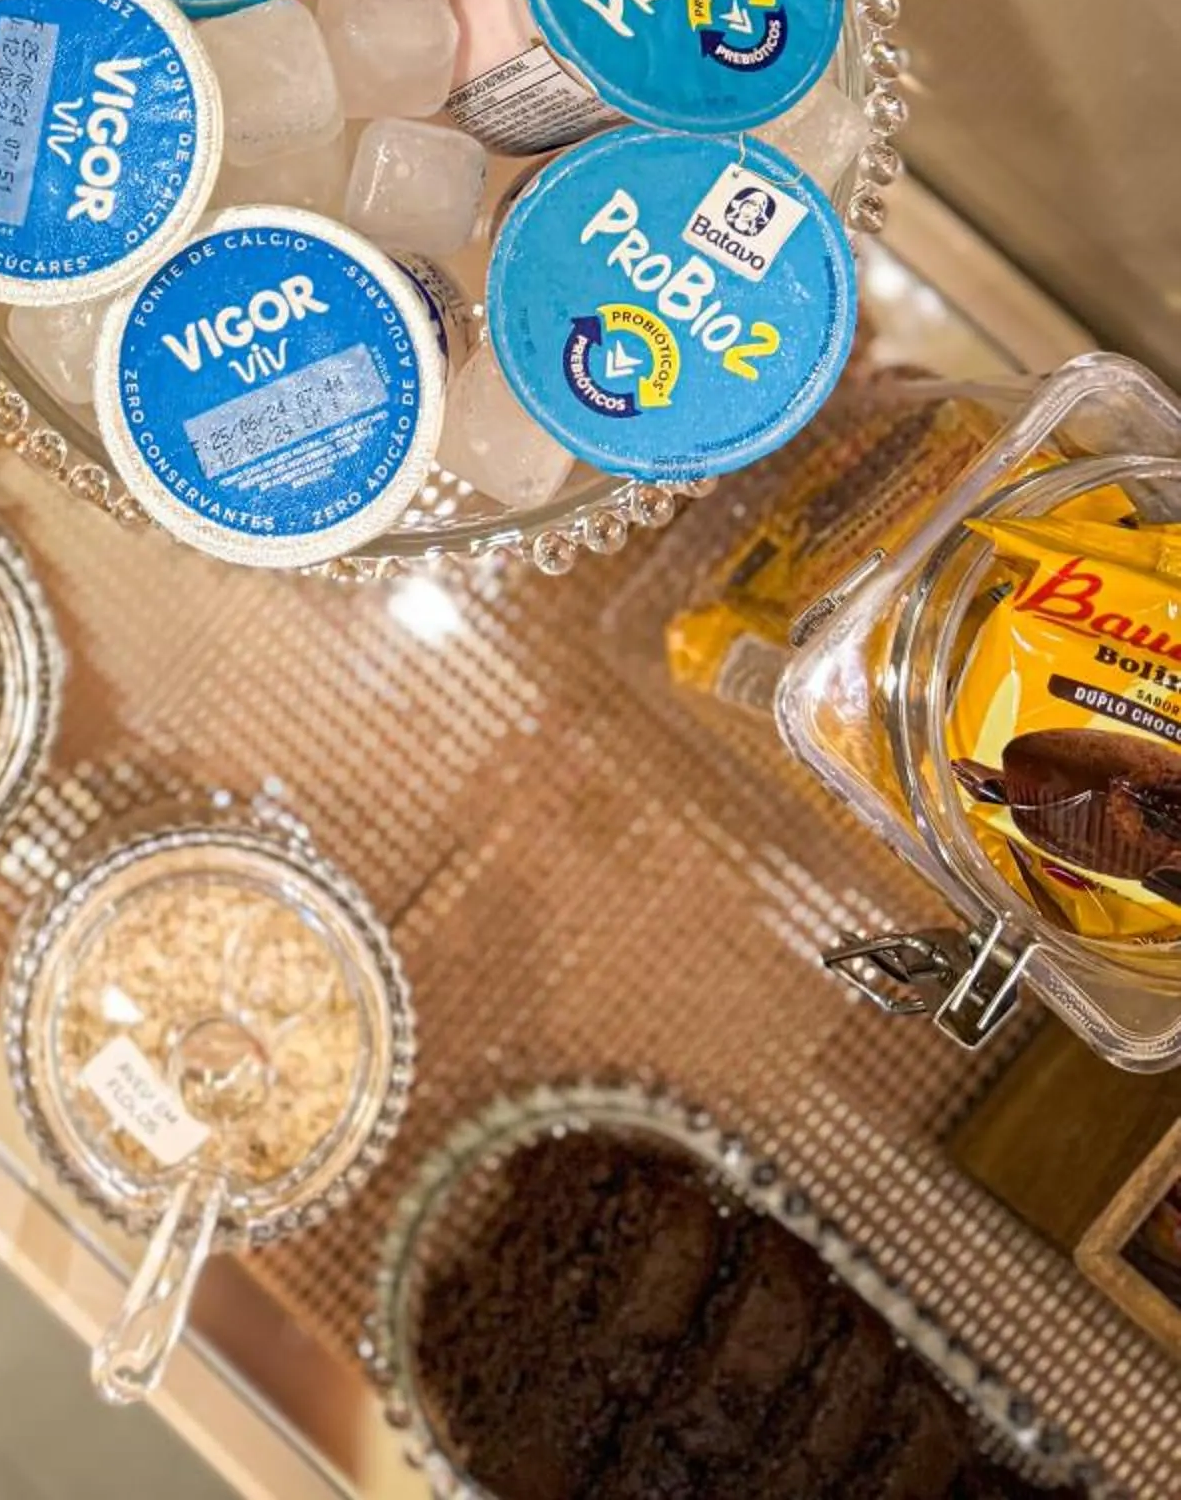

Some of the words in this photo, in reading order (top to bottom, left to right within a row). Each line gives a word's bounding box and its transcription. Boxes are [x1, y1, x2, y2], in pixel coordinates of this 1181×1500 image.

[67, 57, 142, 223] VIGOR
[174, 133, 194, 163] DE
[689, 213, 766, 272] Batavo
[134, 265, 184, 328] FONTE
[188, 243, 216, 267] DE
[161, 274, 330, 373] VIGOR
[123, 369, 145, 424] ZERO
[139, 432, 275, 531] CONSERVANTES
[312, 490, 363, 527] ZERO
[365, 416, 411, 491] ADIÇÃO
[401, 379, 416, 406] DE
[1074, 686, 1128, 716] DUPLO
[1135, 688, 1180, 716] SABOR
